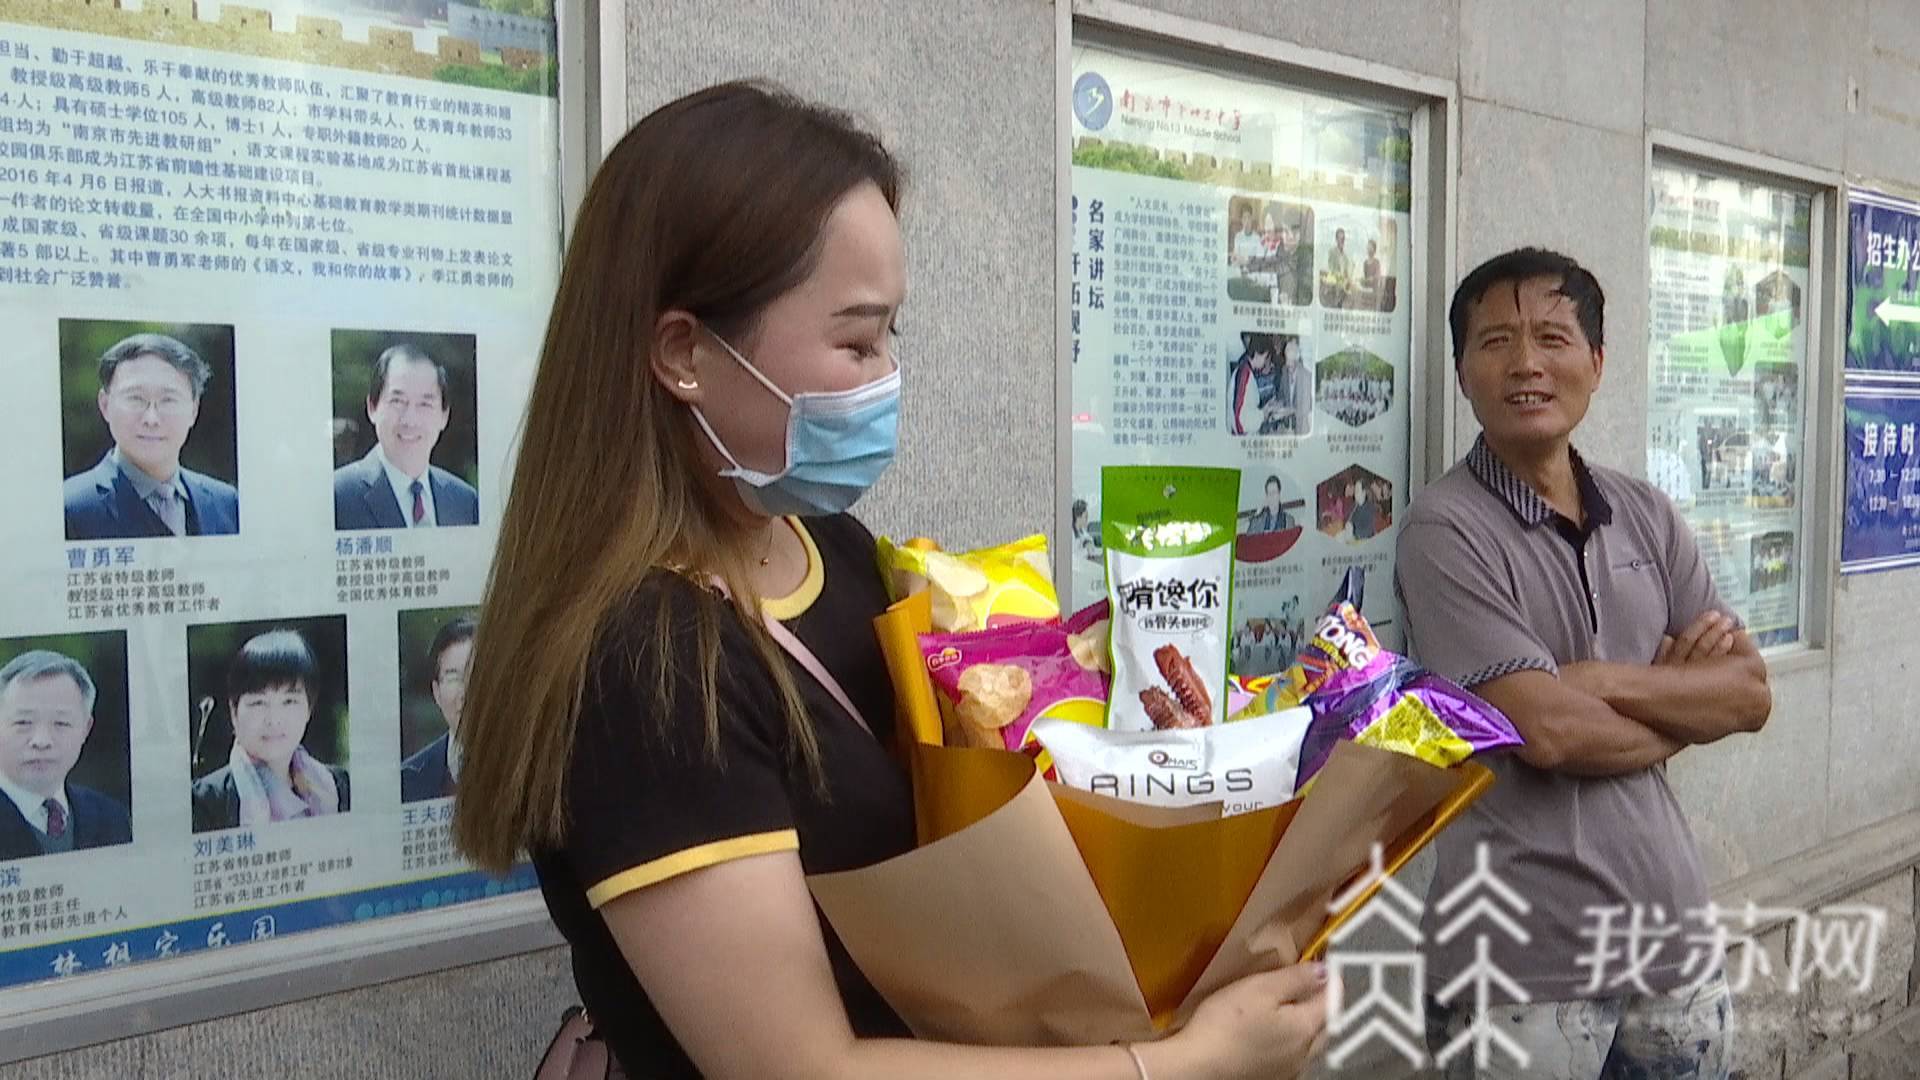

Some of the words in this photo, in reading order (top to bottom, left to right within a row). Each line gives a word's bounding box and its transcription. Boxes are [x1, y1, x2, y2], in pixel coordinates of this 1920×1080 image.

[1088, 198, 1105, 310] 名家讲坛
[1863, 422, 1914, 457] 接待时
[66, 546, 136, 569] 曹勇军
[336, 556, 425, 572] 江苏省特级教师
[67, 568, 175, 586] 江苏省特级教师
[336, 569, 450, 587] 教授级中学高级教师
[67, 583, 205, 602] 教授级中学高级教师
[337, 584, 439, 603] 全国优秀体育教师
[68, 598, 221, 620] 江苏省优秀教育工作者
[194, 849, 292, 875] 江苏省特级教师
[1, 884, 64, 906] 特级教师
[1, 897, 81, 922] 优秀班主任
[2, 905, 128, 939] 教育科研先进个人
